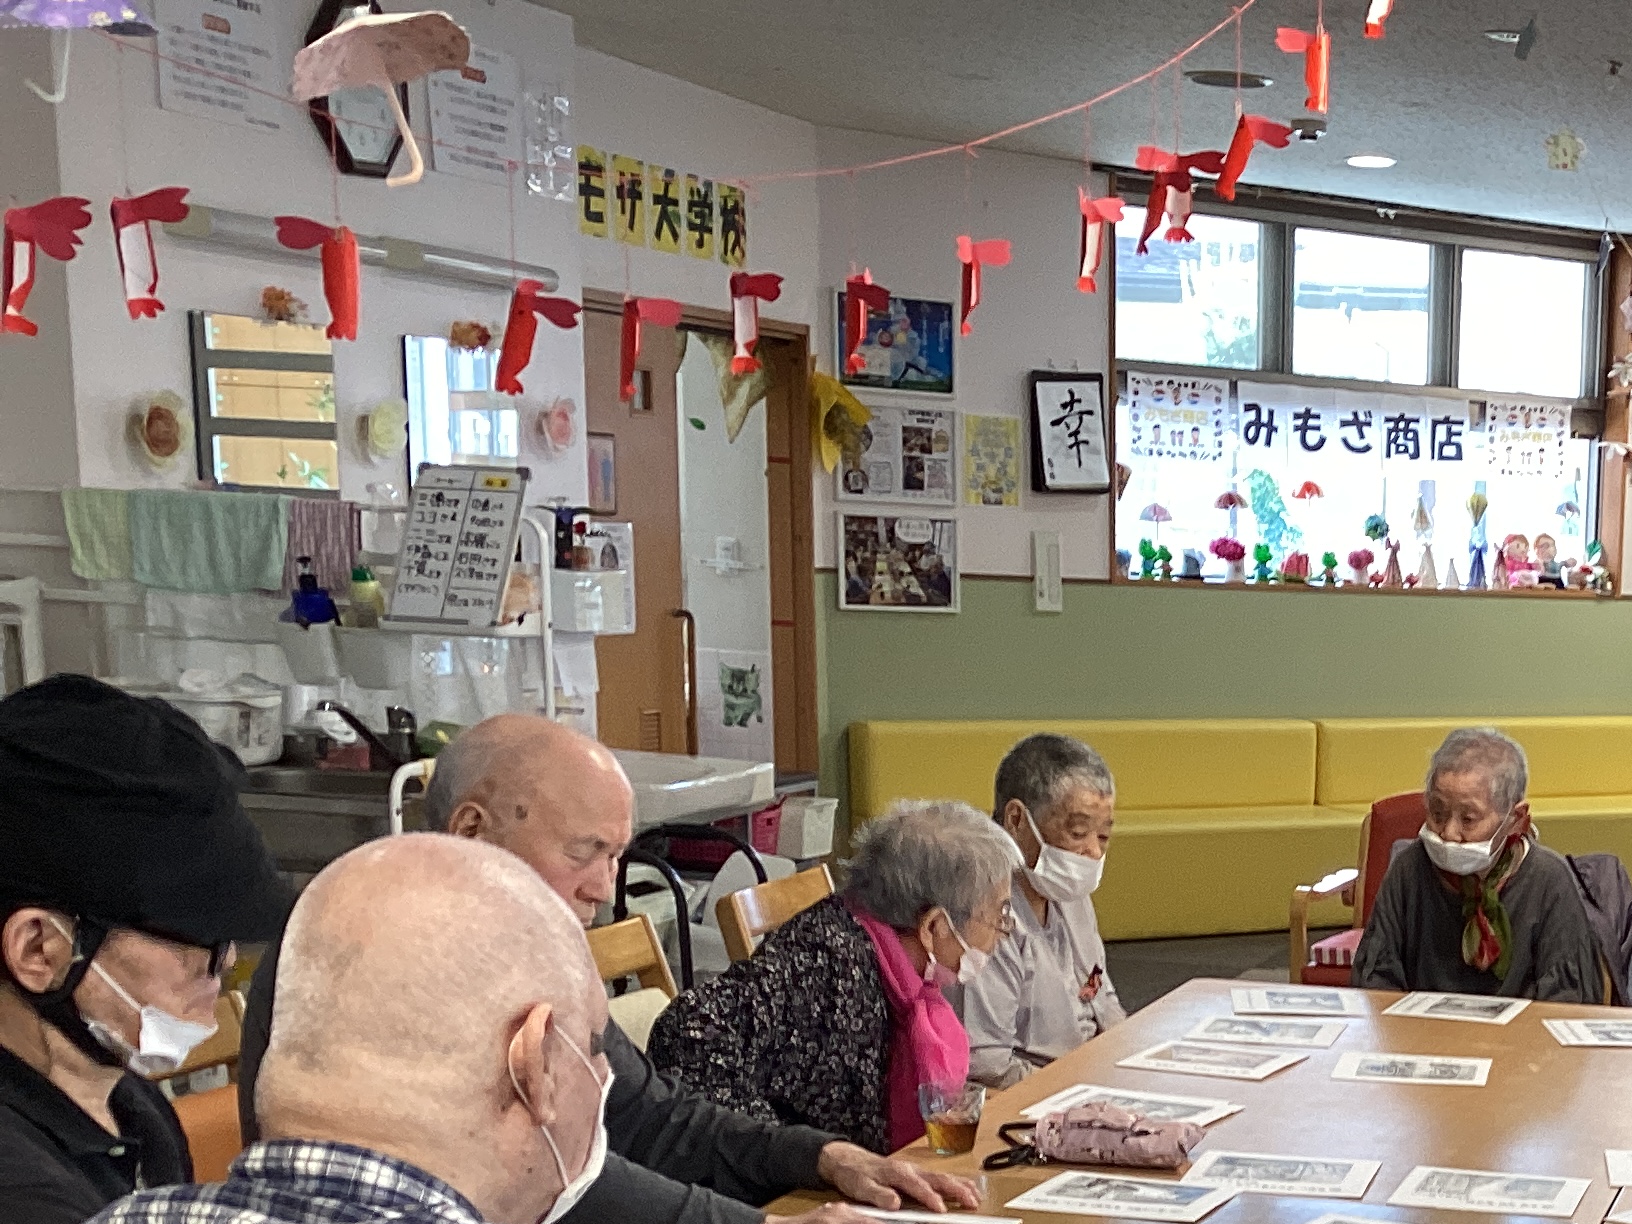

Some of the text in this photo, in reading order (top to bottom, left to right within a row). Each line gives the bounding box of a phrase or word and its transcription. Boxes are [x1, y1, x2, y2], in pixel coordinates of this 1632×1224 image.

[1050, 387, 1094, 468] 幸
[1243, 402, 1464, 462] みもざ商店
